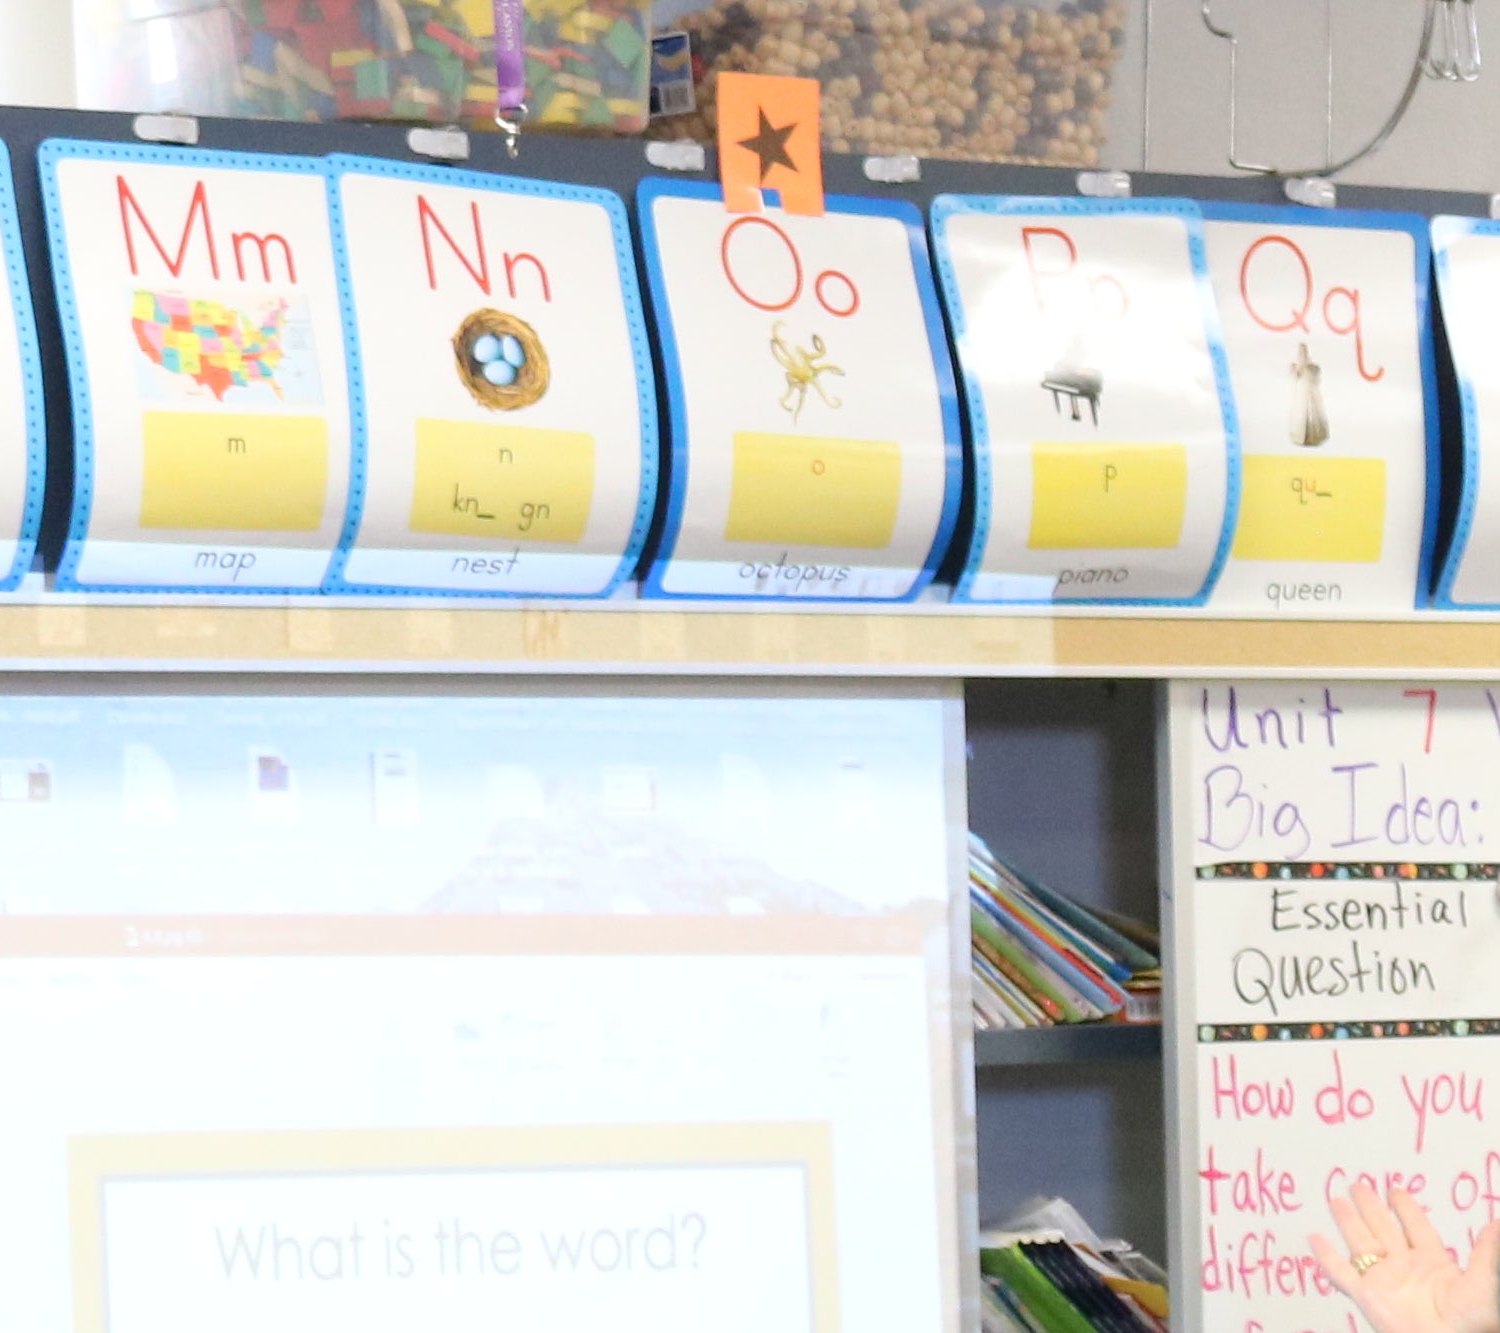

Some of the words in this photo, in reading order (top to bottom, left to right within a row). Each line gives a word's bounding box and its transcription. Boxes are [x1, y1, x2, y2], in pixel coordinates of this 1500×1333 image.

[193, 546, 258, 574] map
[450, 548, 520, 577] nest
[738, 550, 849, 586] octopus
[1056, 562, 1129, 591] piano
[1266, 579, 1342, 605] queen
[1201, 687, 1343, 752] Unit
[1403, 689, 1437, 755] 7
[1198, 764, 1312, 862] Big
[1330, 762, 1484, 849] Idea:
[1271, 881, 1469, 934] Essential
[1232, 939, 1438, 1017] Question
[1212, 1053, 1295, 1122] How
[1314, 1048, 1375, 1126] do
[1401, 1071, 1485, 1155] you
[1197, 1144, 1304, 1217] take
[211, 1221, 363, 1284] What
[378, 1219, 416, 1277] is
[430, 1212, 528, 1277] the
[536, 1208, 708, 1275] word?
